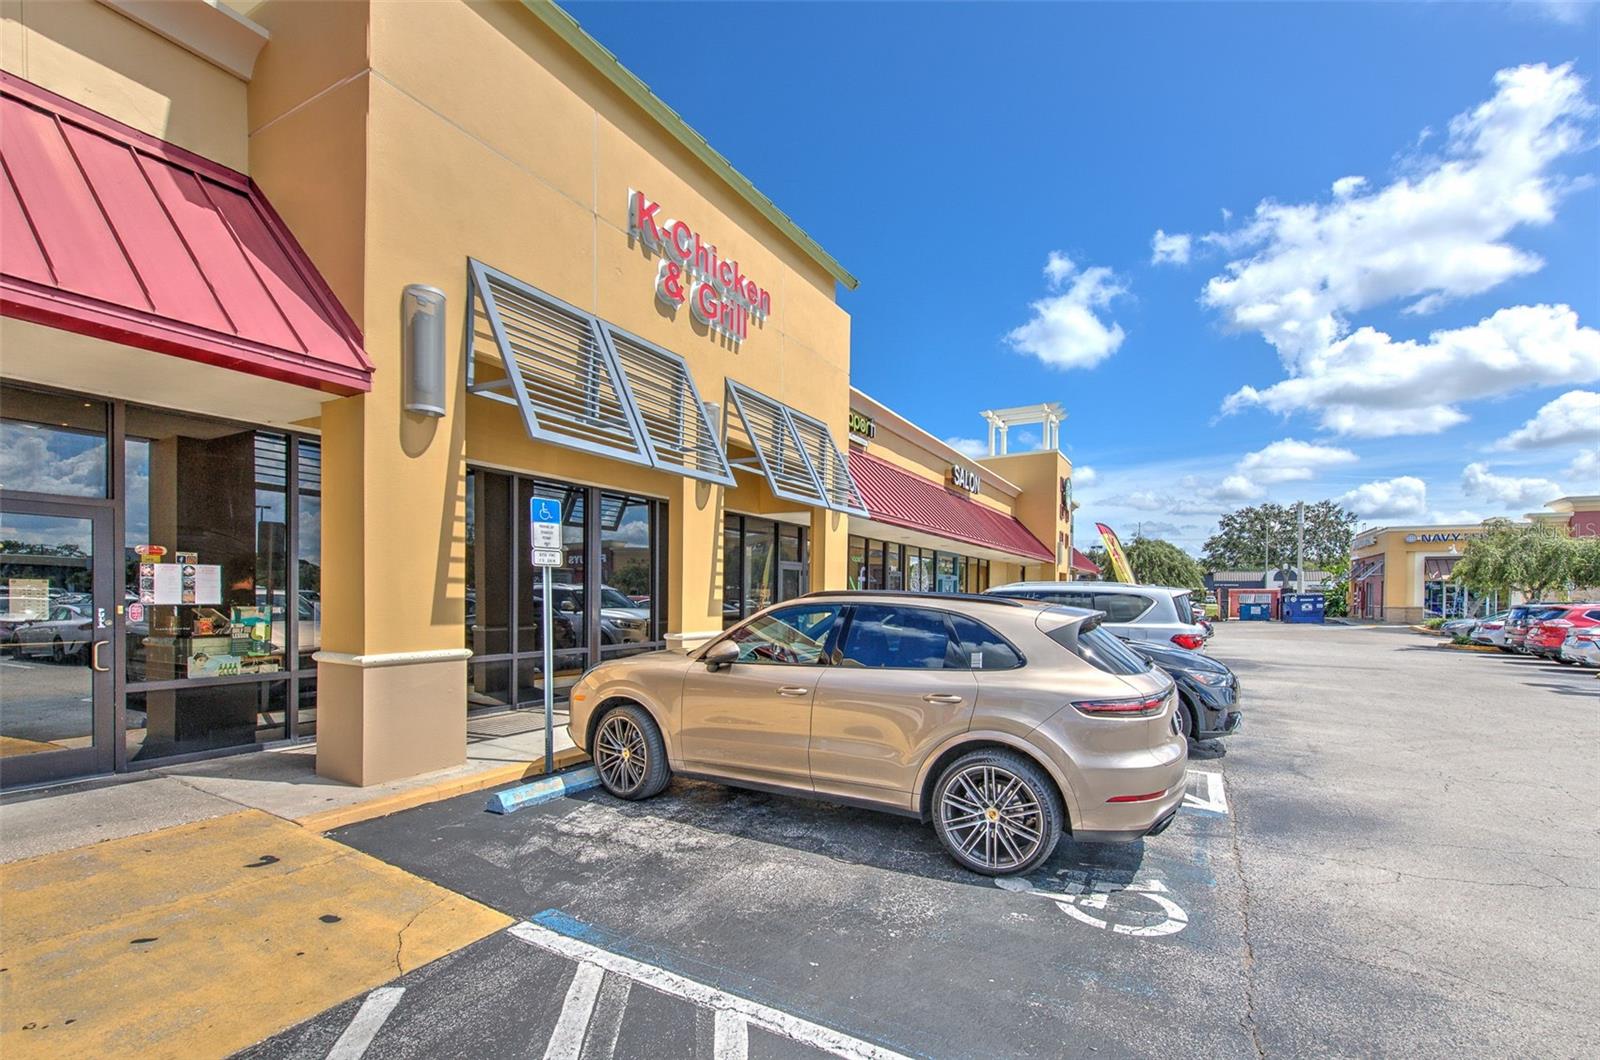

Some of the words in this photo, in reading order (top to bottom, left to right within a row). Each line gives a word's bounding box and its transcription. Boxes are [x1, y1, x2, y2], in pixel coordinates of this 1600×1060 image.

[630, 188, 771, 318] K-Chicken
[659, 261, 686, 306] &
[693, 282, 748, 341] Grill
[953, 464, 981, 494] SALON
[1421, 533, 1461, 542] NAVY
